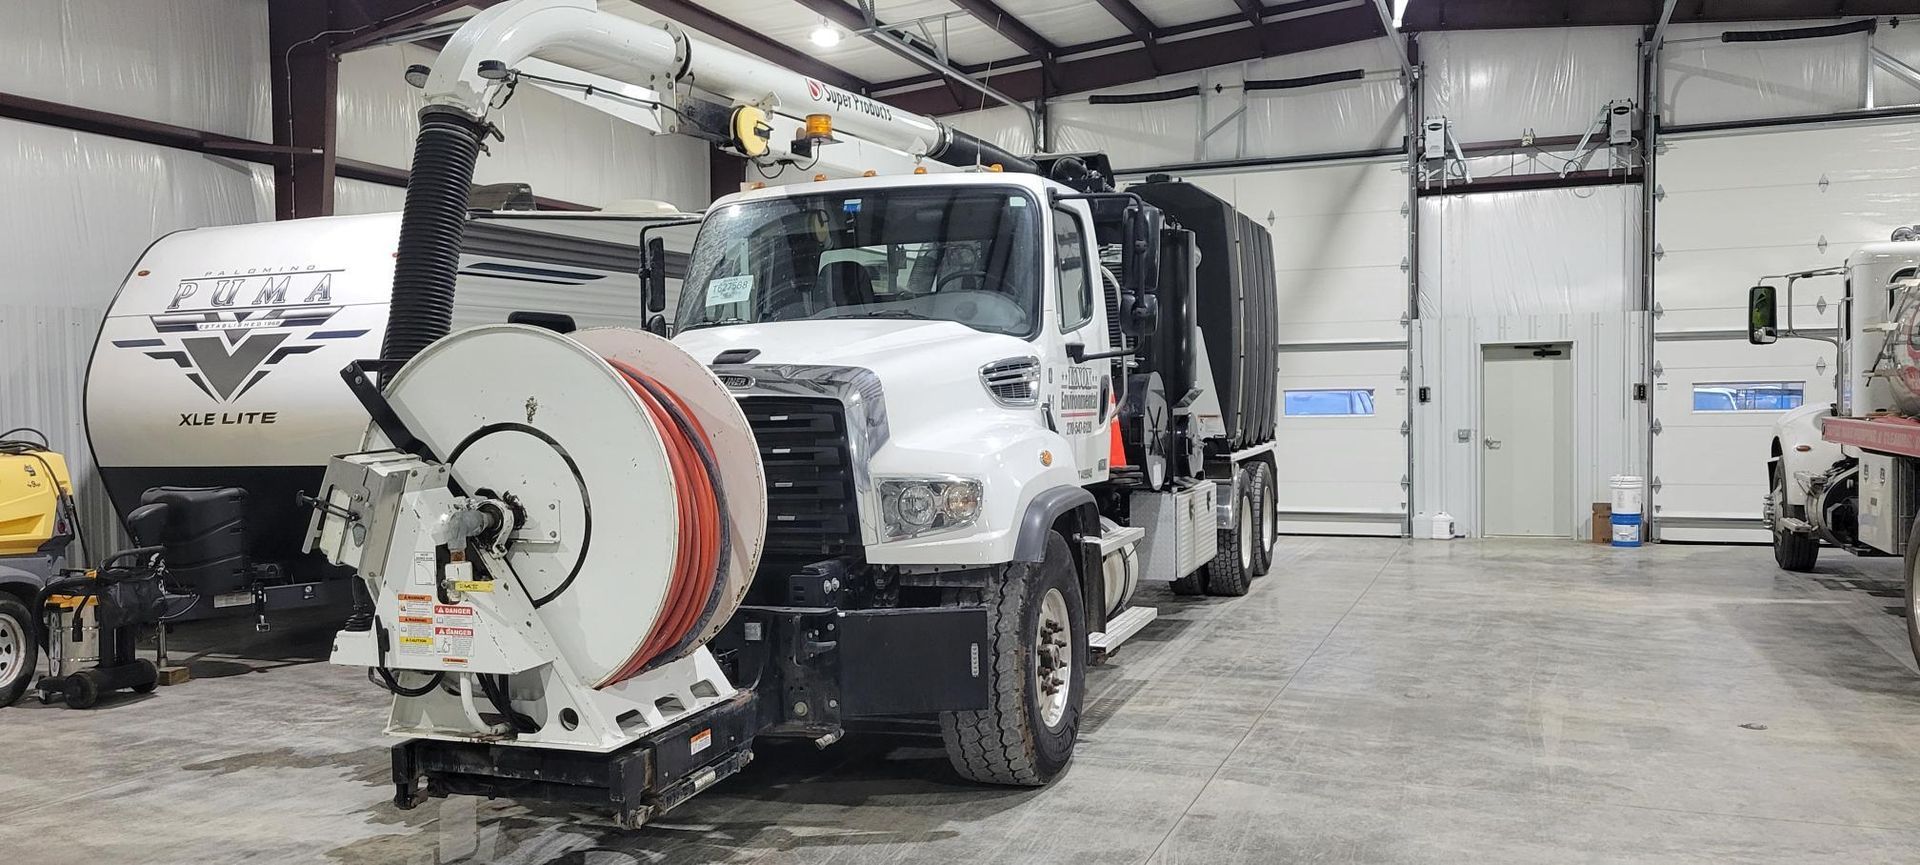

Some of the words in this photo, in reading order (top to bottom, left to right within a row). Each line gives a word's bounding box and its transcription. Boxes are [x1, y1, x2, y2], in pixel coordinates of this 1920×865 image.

[822, 83, 852, 112] Super
[851, 93, 892, 121] Products
[205, 265, 316, 277] PALOMINO
[167, 273, 332, 309] PUMA
[199, 321, 262, 330] ESTABLISHED
[1061, 391, 1098, 410] Environmental
[179, 412, 216, 427] XLE
[222, 411, 278, 425] LITE
[446, 628, 472, 636] DANGER
